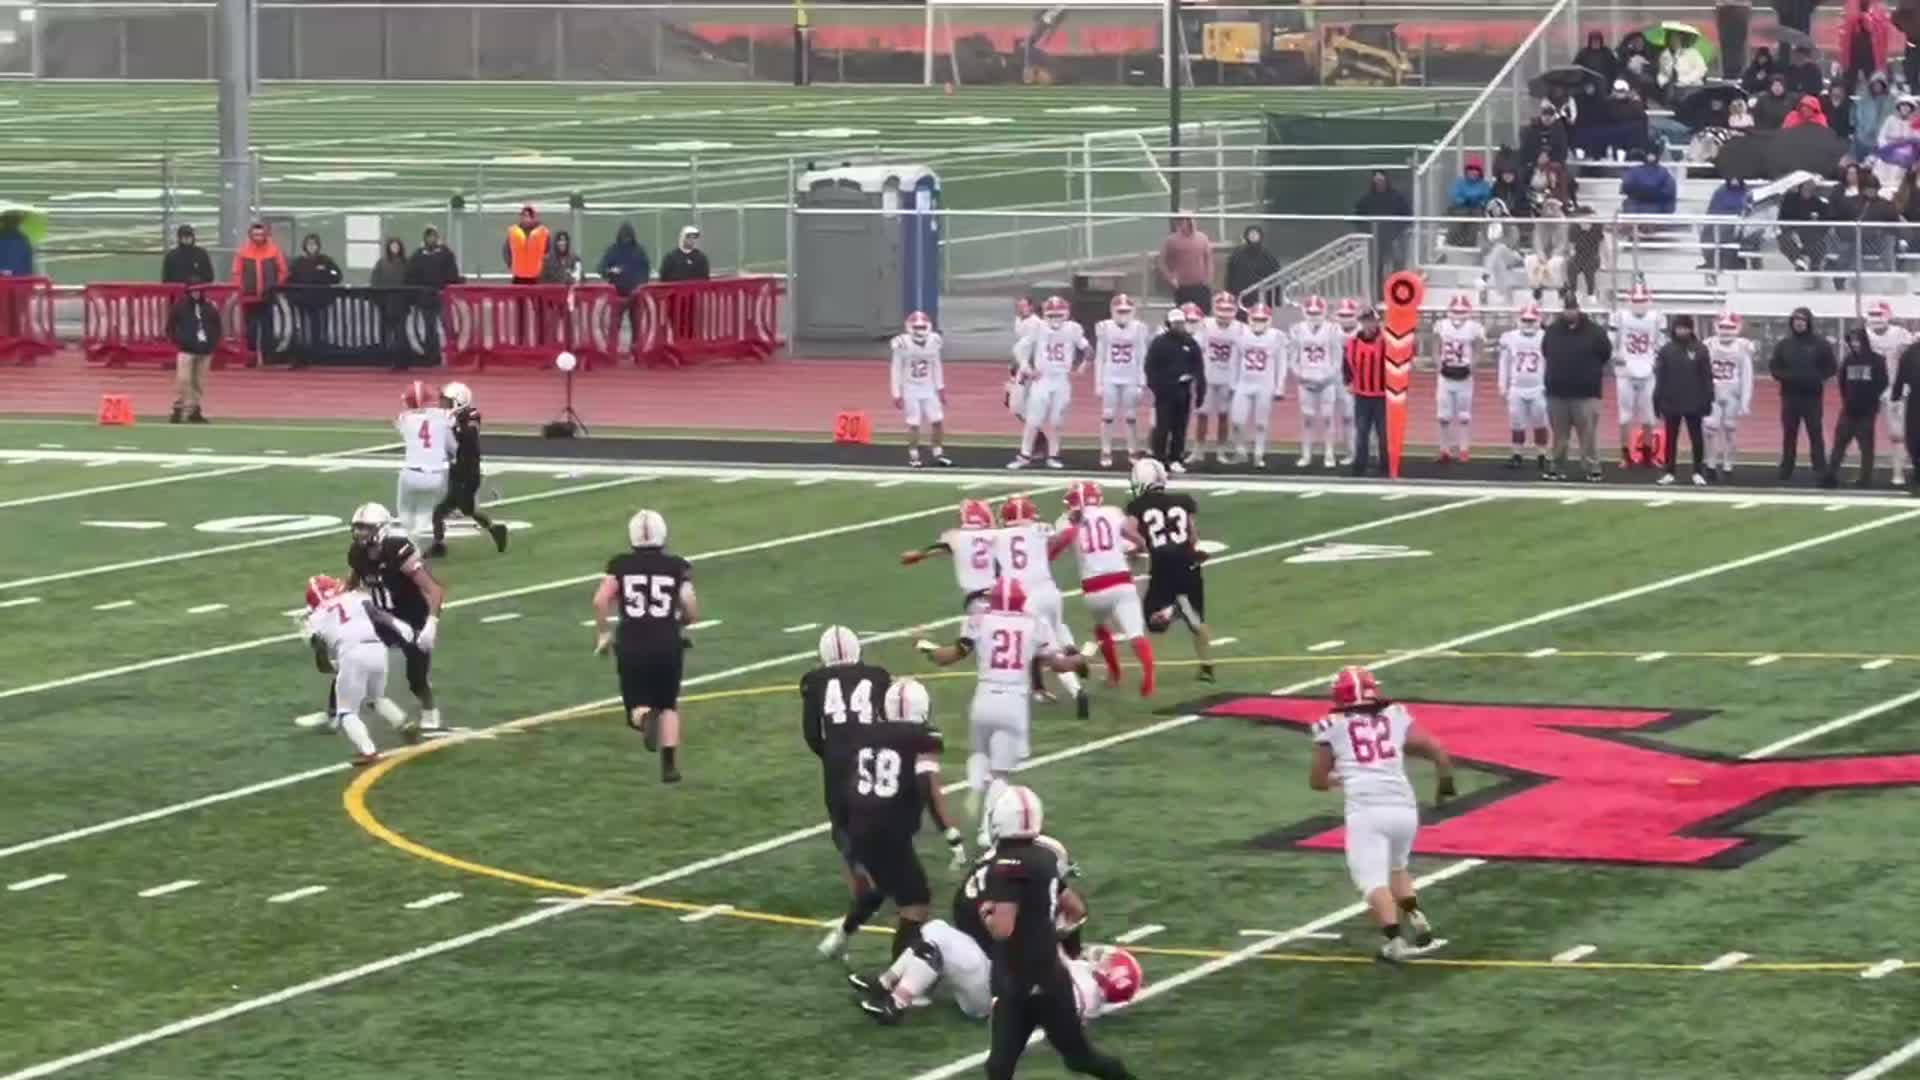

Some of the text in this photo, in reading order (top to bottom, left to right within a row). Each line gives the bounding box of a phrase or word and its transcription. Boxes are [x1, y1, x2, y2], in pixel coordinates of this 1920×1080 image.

[1515, 351, 1539, 374] 73
[417, 420, 433, 449] 4
[836, 414, 861, 438] 30
[1082, 515, 1114, 553] 10
[1142, 506, 1189, 548] 23
[1011, 535, 1028, 569] 6
[336, 601, 350, 625] 7
[622, 575, 676, 619] 55
[990, 629, 1024, 671] 21
[823, 679, 874, 724] 44
[1347, 716, 1396, 764] 62
[856, 748, 901, 798] 58
